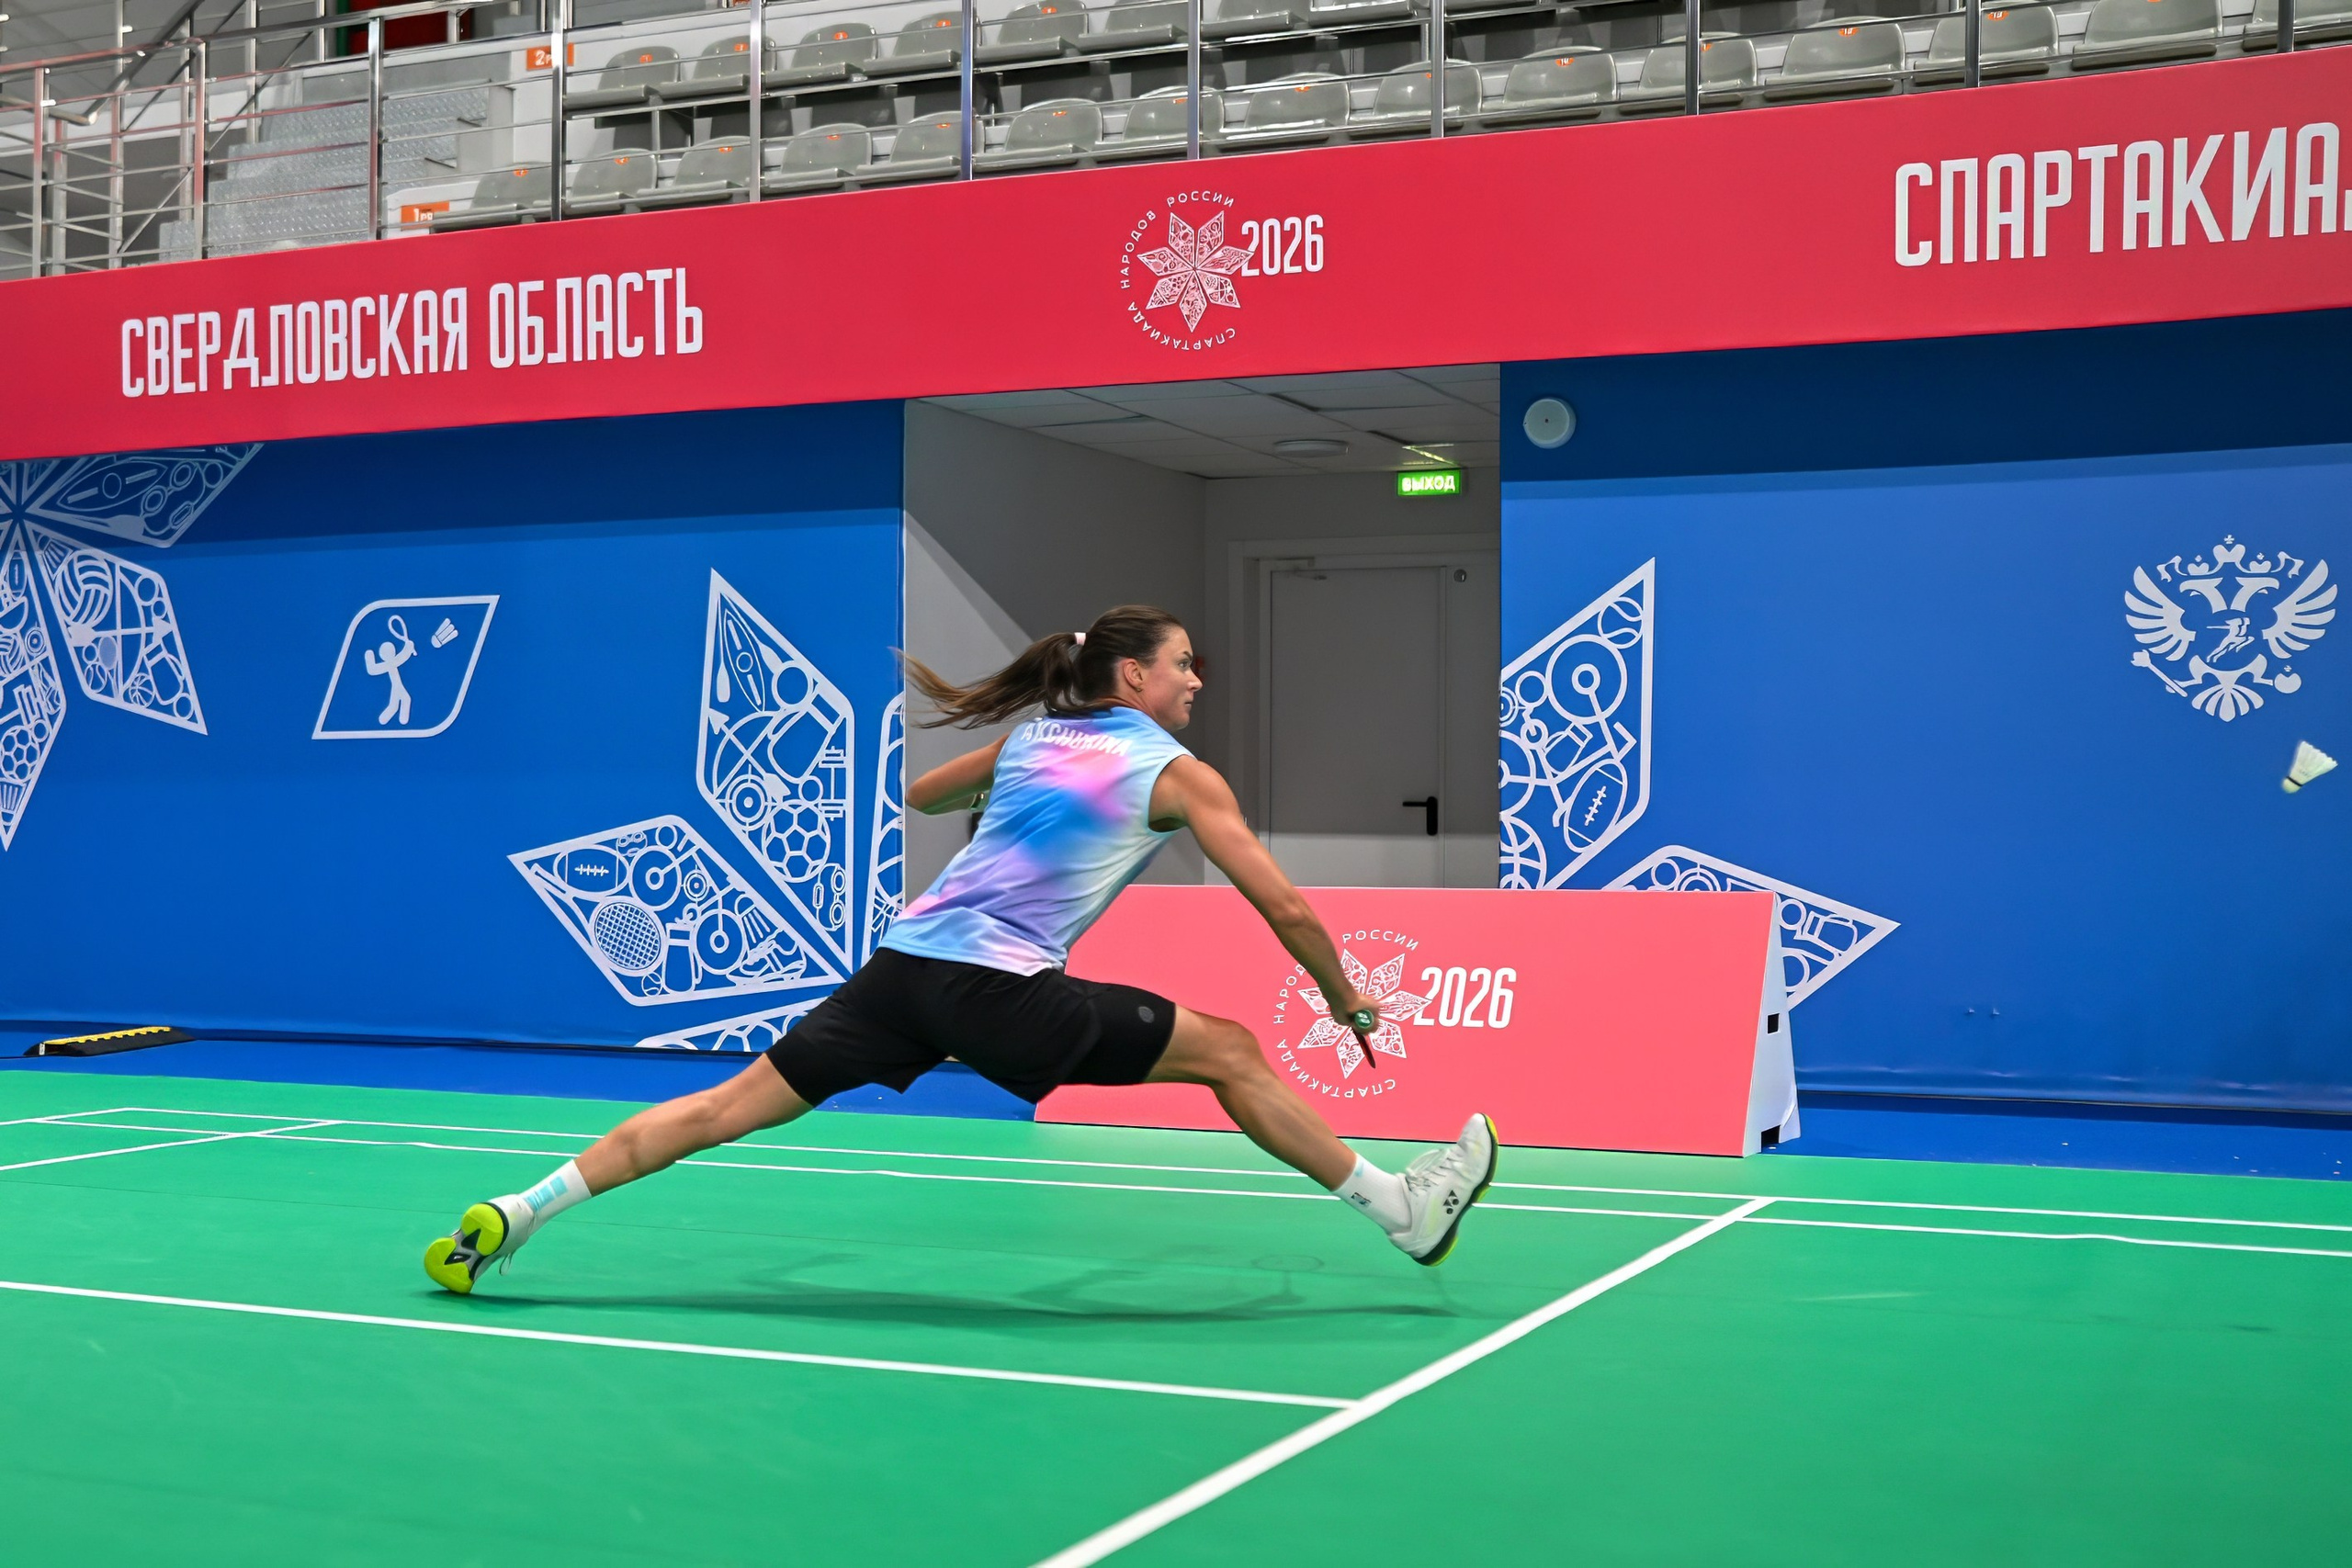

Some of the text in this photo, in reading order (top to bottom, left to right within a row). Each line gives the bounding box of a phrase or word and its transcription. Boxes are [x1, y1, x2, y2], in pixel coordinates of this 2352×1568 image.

[1240, 214, 1324, 277] 2026
[1894, 121, 2352, 267] СПАРТАКИА
[121, 267, 705, 399] СВЕРДЛОВСКАЯ ОБЛАСТЬ
[1119, 190, 1236, 351] СПАРТАКИАДА НАРОДОВ РОССИИ
[1401, 475, 1456, 492] ВЫХОД
[1272, 929, 1419, 1099] СПАРТАКИАДА НАРОД РОССИИ
[1412, 966, 1517, 1030] 2026
